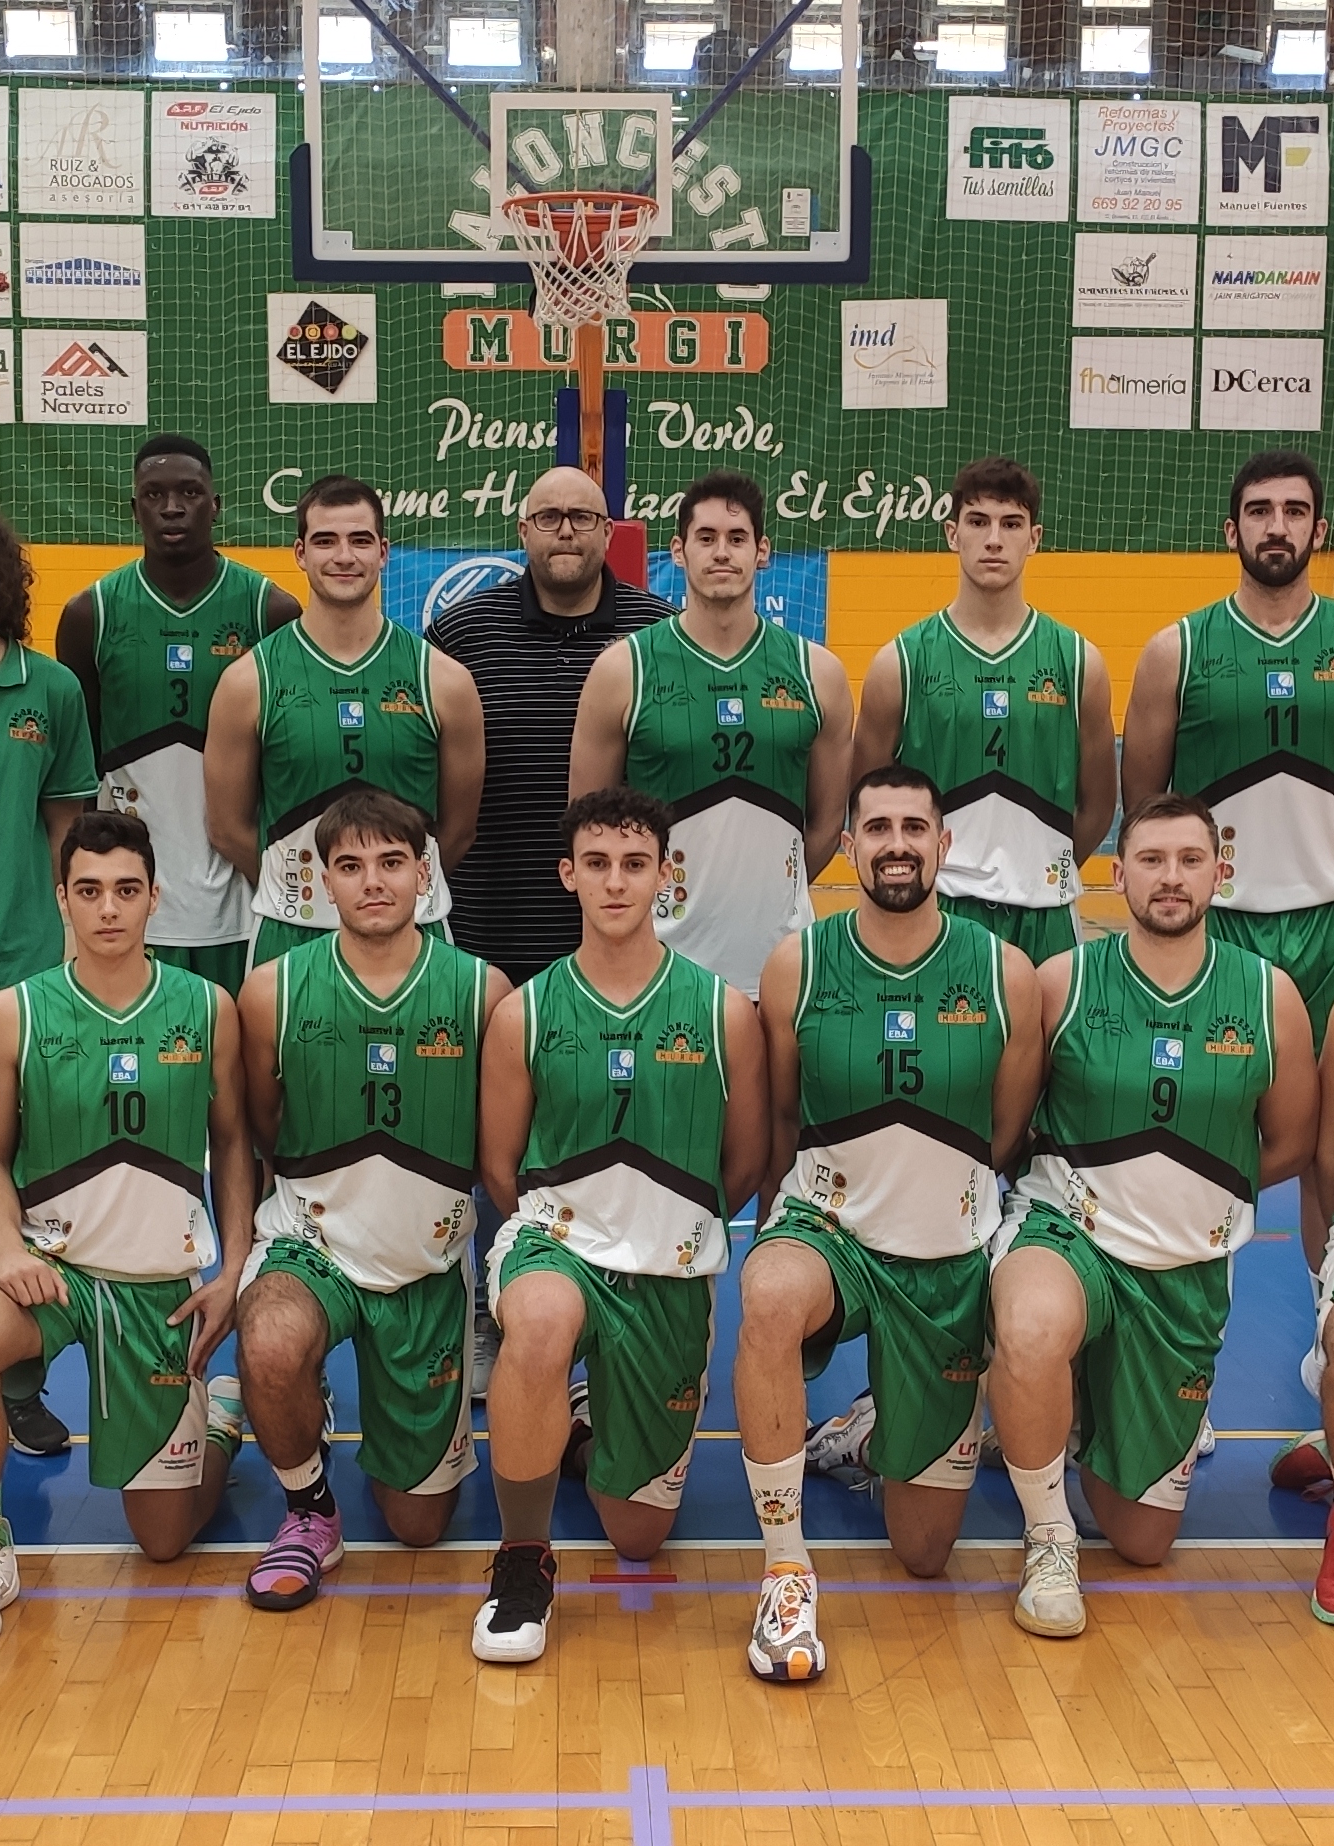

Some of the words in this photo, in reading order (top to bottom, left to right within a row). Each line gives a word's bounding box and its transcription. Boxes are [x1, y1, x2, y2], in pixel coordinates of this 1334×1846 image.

[209, 105, 224, 113] El
[227, 106, 262, 115] Ejido
[1098, 106, 1168, 119] Reformas
[181, 120, 248, 131] NUTRICIÓN
[1102, 119, 1175, 134] Proyectos
[1094, 136, 1183, 158] JMGC
[50, 159, 83, 172] RUIZ
[88, 160, 98, 172] &
[49, 175, 134, 188] ABOGADOS
[963, 175, 985, 195] Tus
[987, 175, 1054, 197] semillas
[1092, 197, 1118, 210] 669
[1143, 199, 1161, 211] 20
[1165, 199, 1183, 211] 95
[1220, 202, 1260, 210] Manuel
[1264, 202, 1308, 211] Fuentes
[1212, 271, 1320, 285] NAANDANJAIN
[850, 322, 897, 346] imd
[287, 344, 306, 359] EL
[311, 344, 358, 359] EJIDO
[42, 380, 104, 397] Palets
[41, 398, 128, 414] Navarro
[647, 401, 784, 457] Verde,
[777, 470, 828, 522] El
[170, 661, 186, 669] EBA
[170, 678, 189, 717] 3
[1270, 687, 1288, 696] EBA
[720, 715, 738, 723] EBA
[1264, 704, 1299, 747] 11
[342, 734, 364, 775] 5
[711, 731, 755, 773] 32
[985, 726, 1006, 767] 4
[284, 872, 298, 918] EJIDO
[888, 1030, 908, 1039] EBA
[370, 1062, 390, 1072] EBA
[611, 1068, 628, 1078] EBA
[877, 1049, 925, 1095] 15
[112, 1072, 131, 1080] EBA
[361, 1081, 402, 1128] 13
[1151, 1077, 1178, 1123] 9
[104, 1090, 146, 1136] 10
[612, 1088, 632, 1135] 7
[169, 1440, 199, 1456] um
